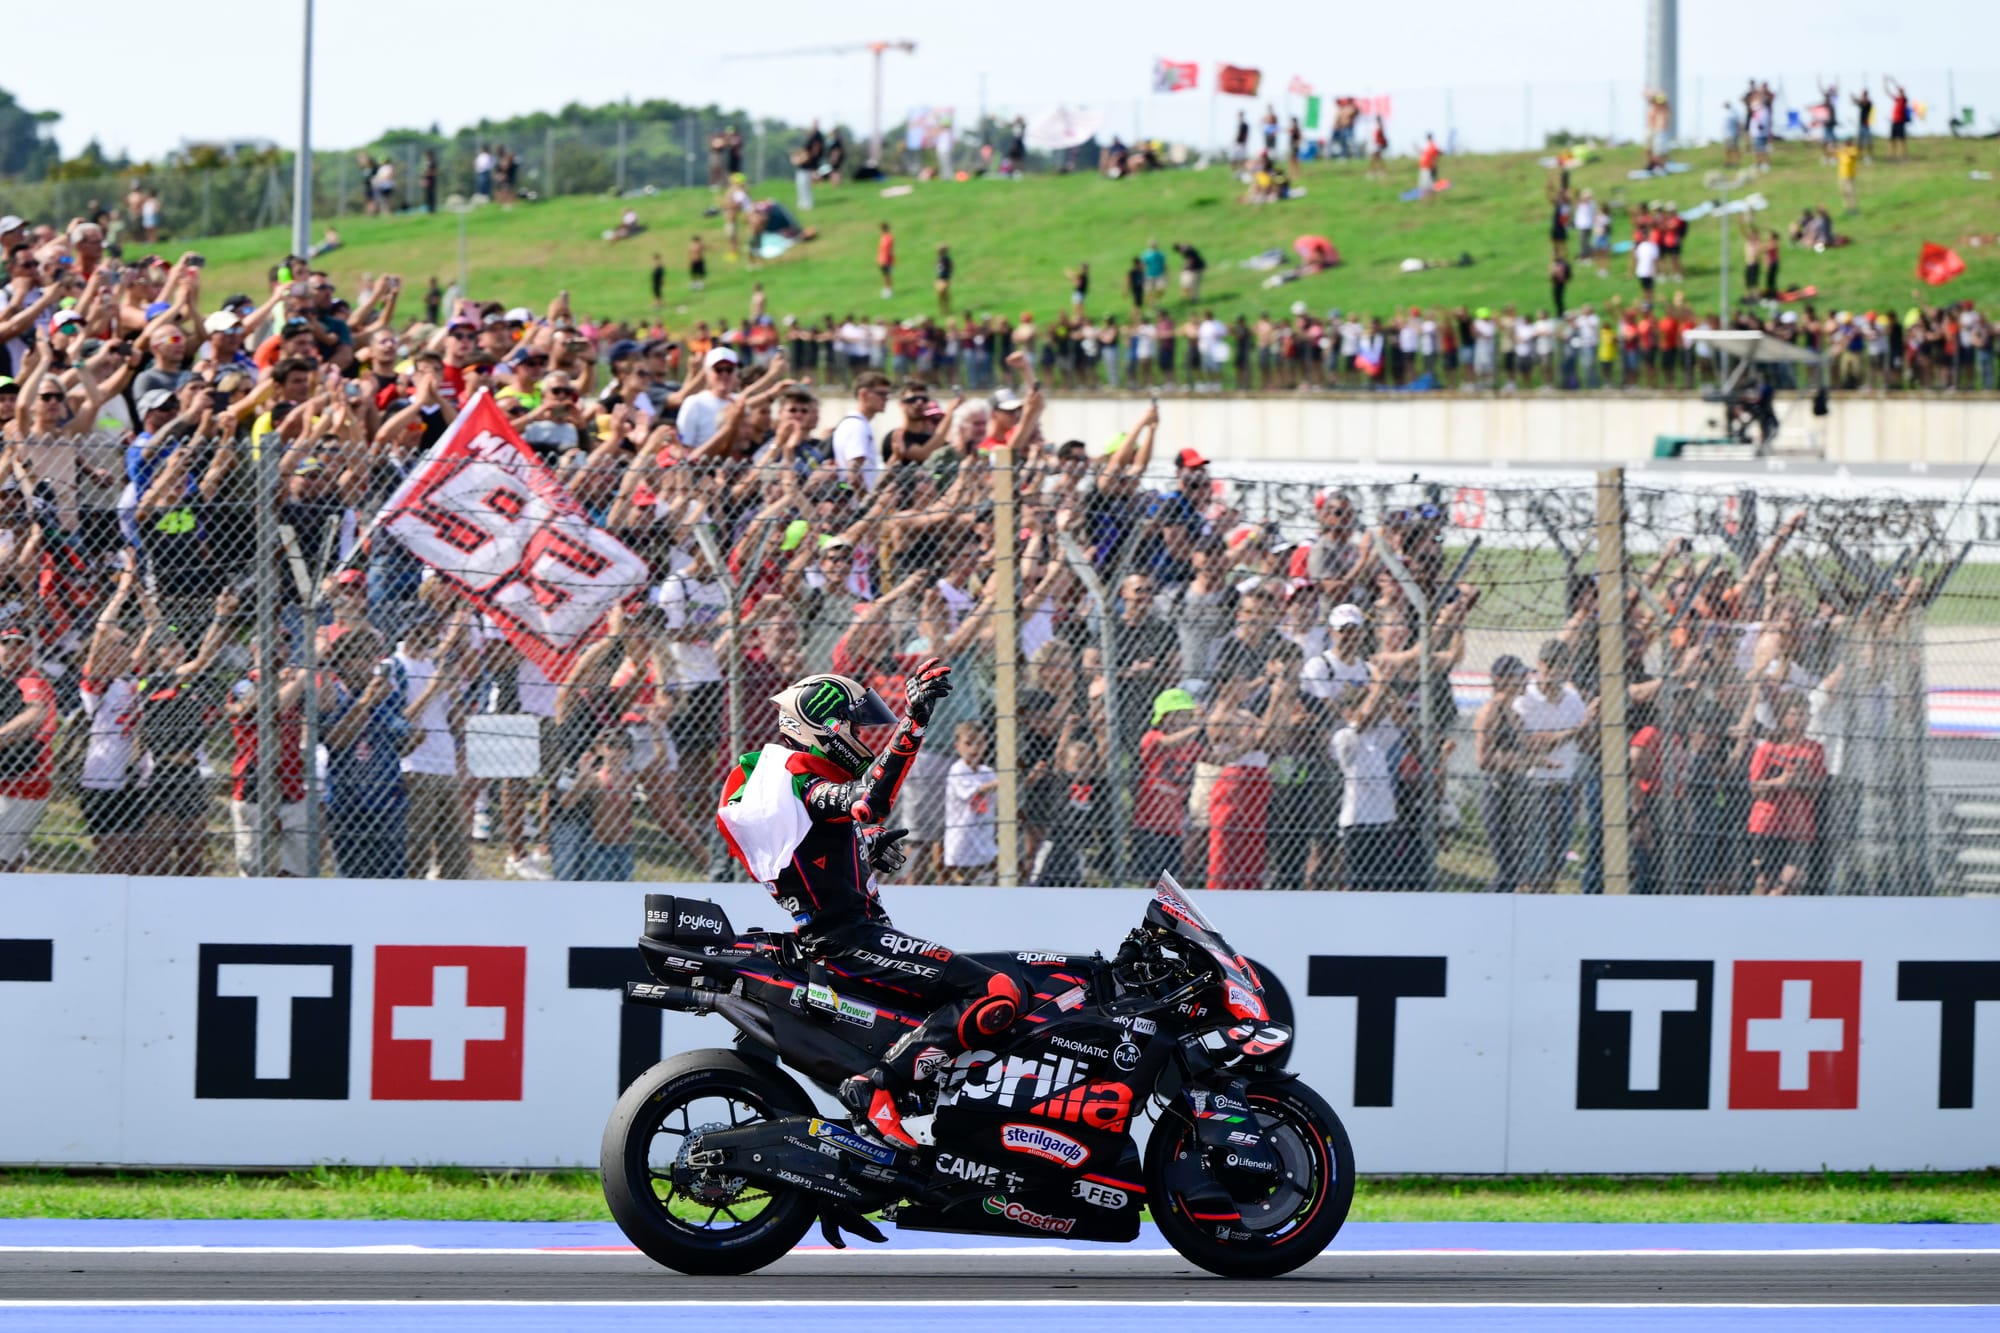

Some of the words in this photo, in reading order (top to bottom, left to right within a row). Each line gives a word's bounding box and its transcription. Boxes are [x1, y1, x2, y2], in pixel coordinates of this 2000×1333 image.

[677, 911, 723, 935] joykey
[880, 932, 953, 963] aprilia
[1016, 951, 1067, 964] aprilia
[853, 949, 940, 979] DAINESE
[633, 984, 670, 995] SC
[840, 1001, 872, 1020] Power
[1050, 1035, 1109, 1059] PRAGMATIC
[1116, 1050, 1139, 1064] PLAY
[949, 1049, 1134, 1133] prilia
[818, 1141, 842, 1160] RK
[833, 1134, 888, 1159] MICHELIN
[1007, 1127, 1082, 1161] sterilgarda
[935, 1153, 1000, 1186] CAME
[1238, 1156, 1272, 1170] Lifenet.it
[1087, 1186, 1124, 1207] FES
[1005, 1202, 1076, 1234] Castrol
